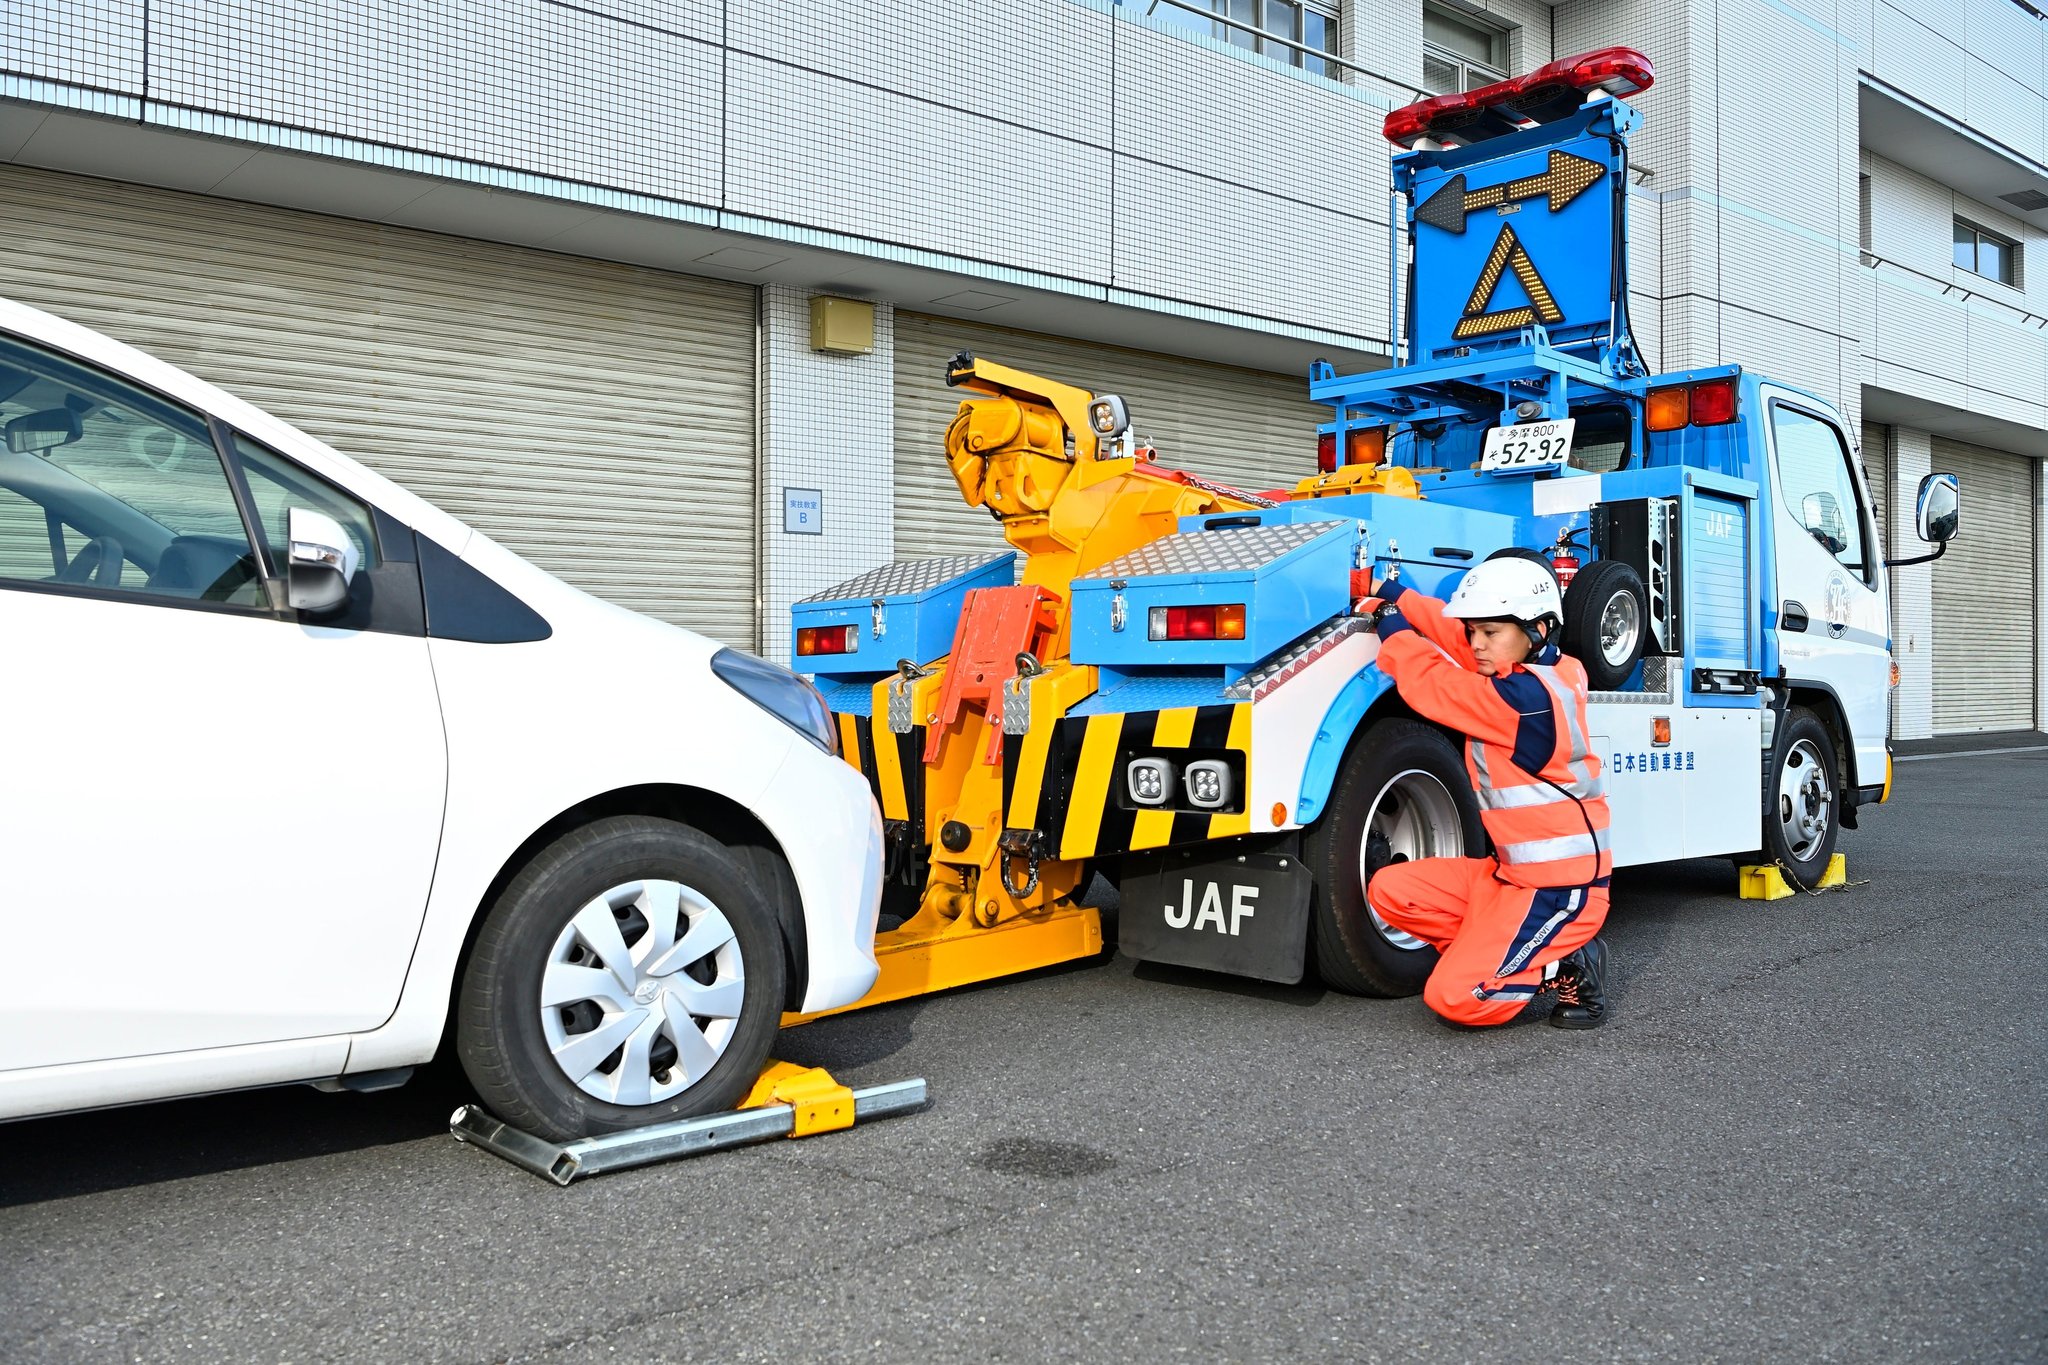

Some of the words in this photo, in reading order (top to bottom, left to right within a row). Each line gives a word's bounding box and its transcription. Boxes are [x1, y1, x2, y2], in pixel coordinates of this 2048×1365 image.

[1532, 424, 1555, 438] 800
[1500, 437, 1566, 465] 52-92
[799, 512, 807, 523] B
[1706, 512, 1732, 538] JAF
[1532, 582, 1550, 595] JAF
[1613, 751, 1695, 773] 日本自動車連盟
[1164, 878, 1260, 936] JAF
